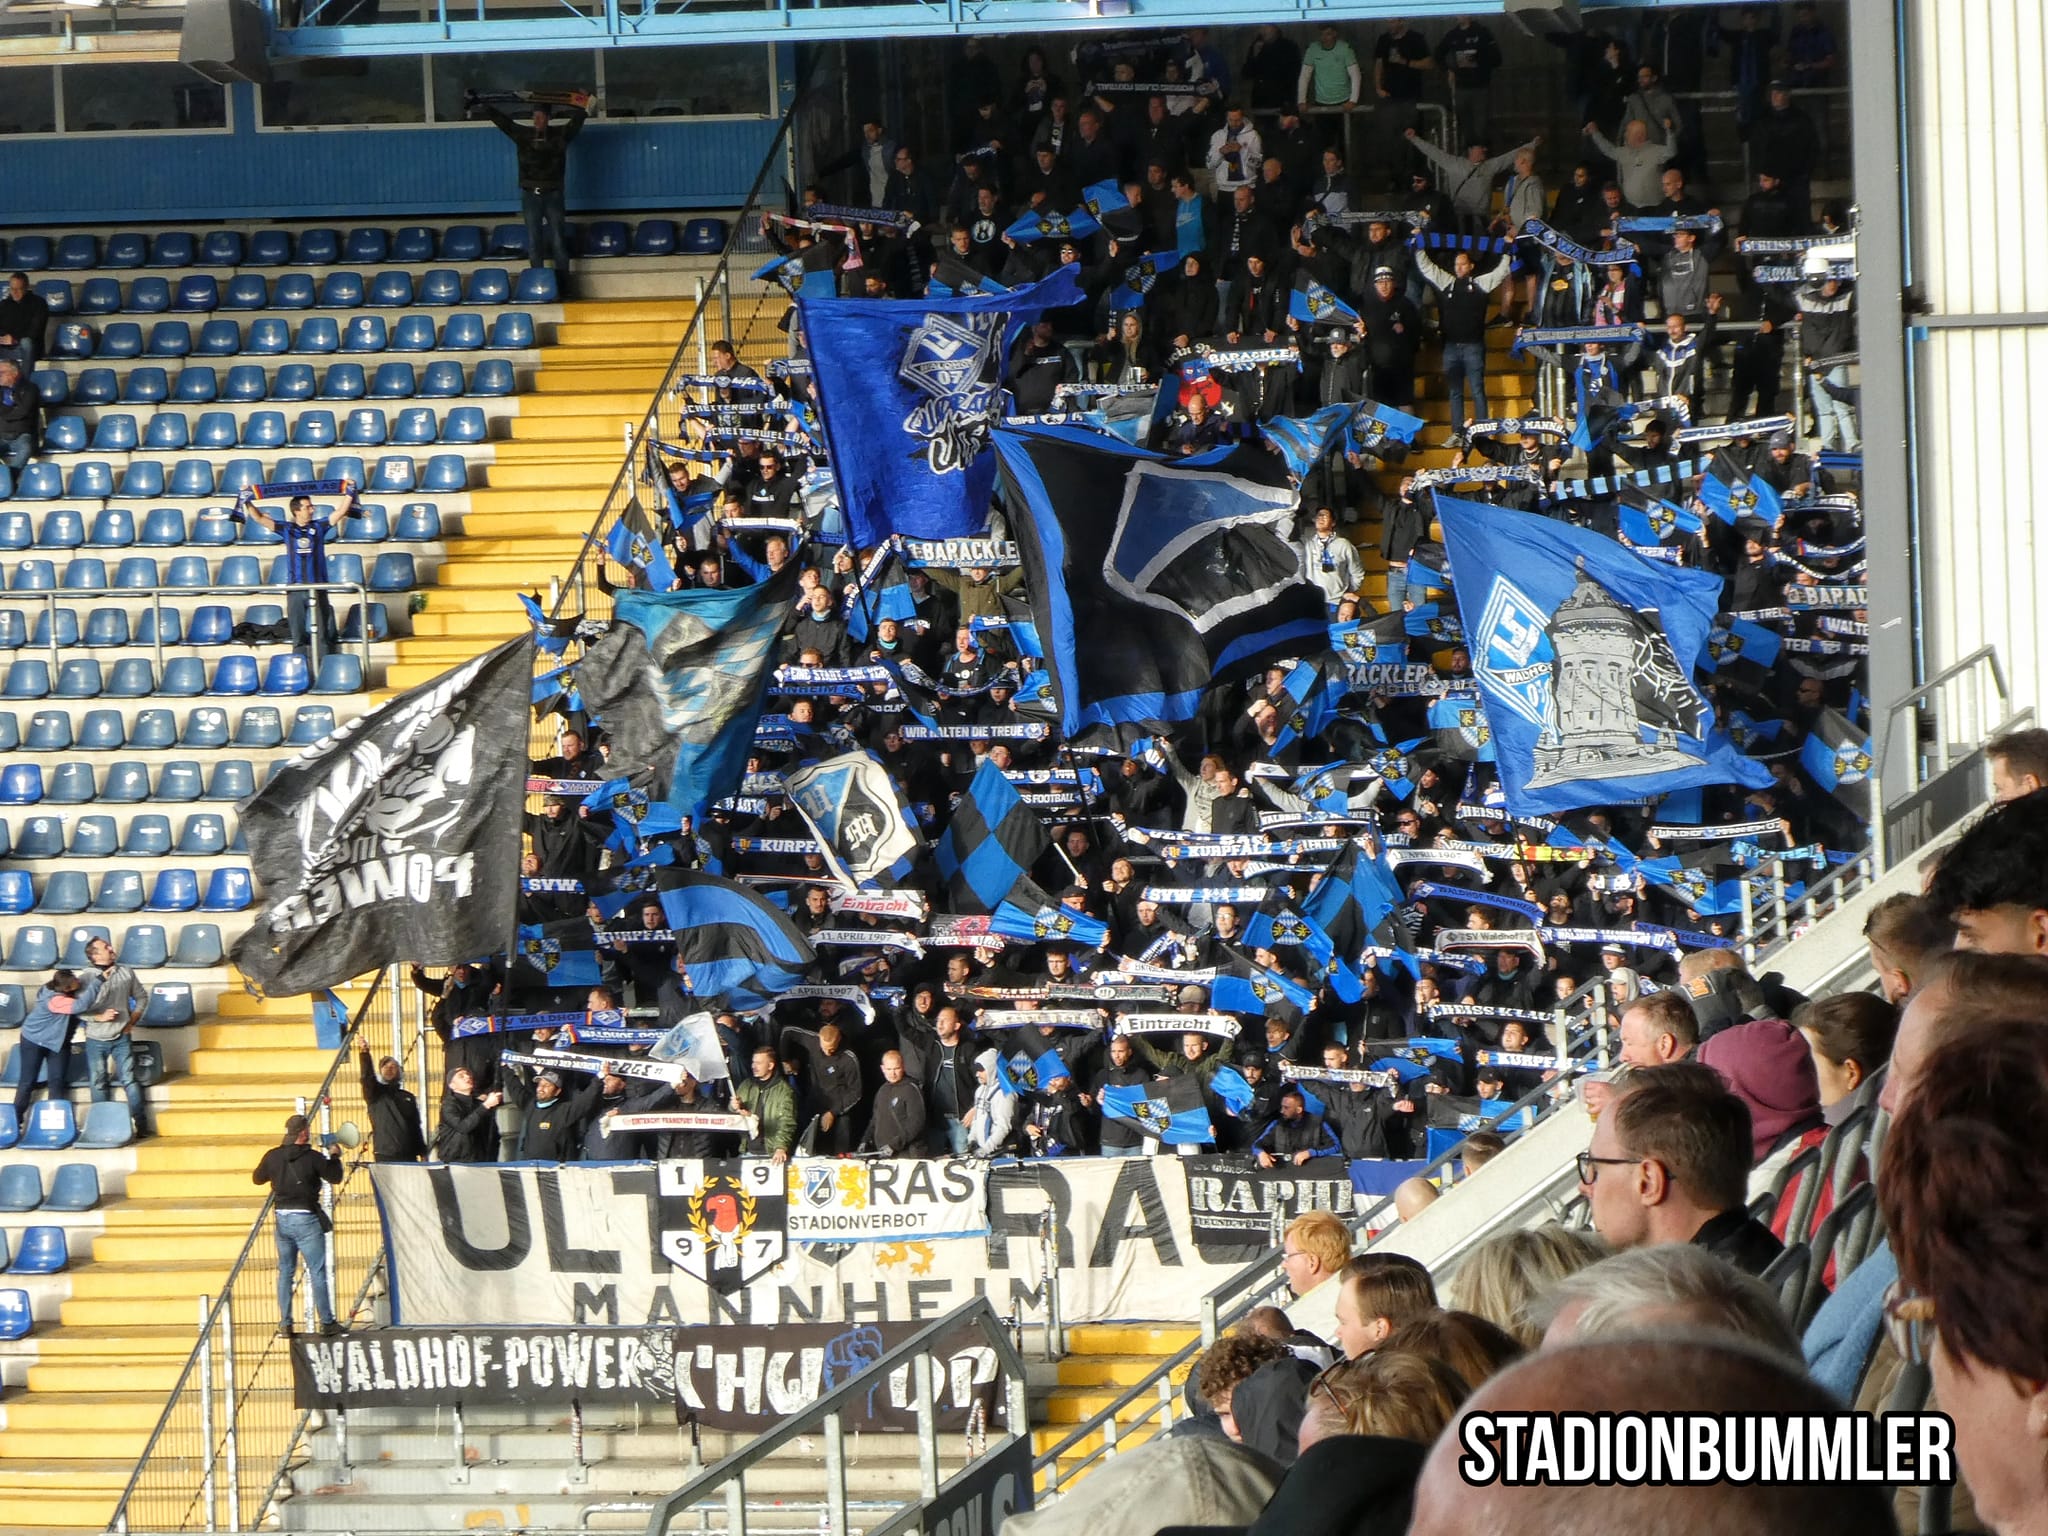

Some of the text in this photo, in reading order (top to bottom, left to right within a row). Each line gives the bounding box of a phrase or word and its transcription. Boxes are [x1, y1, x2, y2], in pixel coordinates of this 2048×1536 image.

[905, 727, 928, 739] WIR
[972, 726, 989, 738] DIE
[990, 725, 1024, 738] TREUE
[1031, 793, 1074, 804] FOOTBALL
[1188, 844, 1273, 857] KURPFALZ
[528, 877, 578, 893] SVW
[1147, 887, 1192, 901] SVW
[841, 897, 910, 914] Eintracht
[837, 932, 867, 942] APRIL
[869, 933, 893, 943] 1907
[827, 988, 853, 1000] 1907
[519, 1013, 583, 1026] WALDHOF
[1127, 1019, 1210, 1032] Eintracht
[676, 1165, 769, 1185] 1 9
[1186, 1176, 1355, 1213] RAPHI
[788, 1213, 927, 1231] STADIONVERBOT
[675, 1237, 772, 1258] 9 7
[306, 1334, 642, 1393] WALDHOF-POWER
